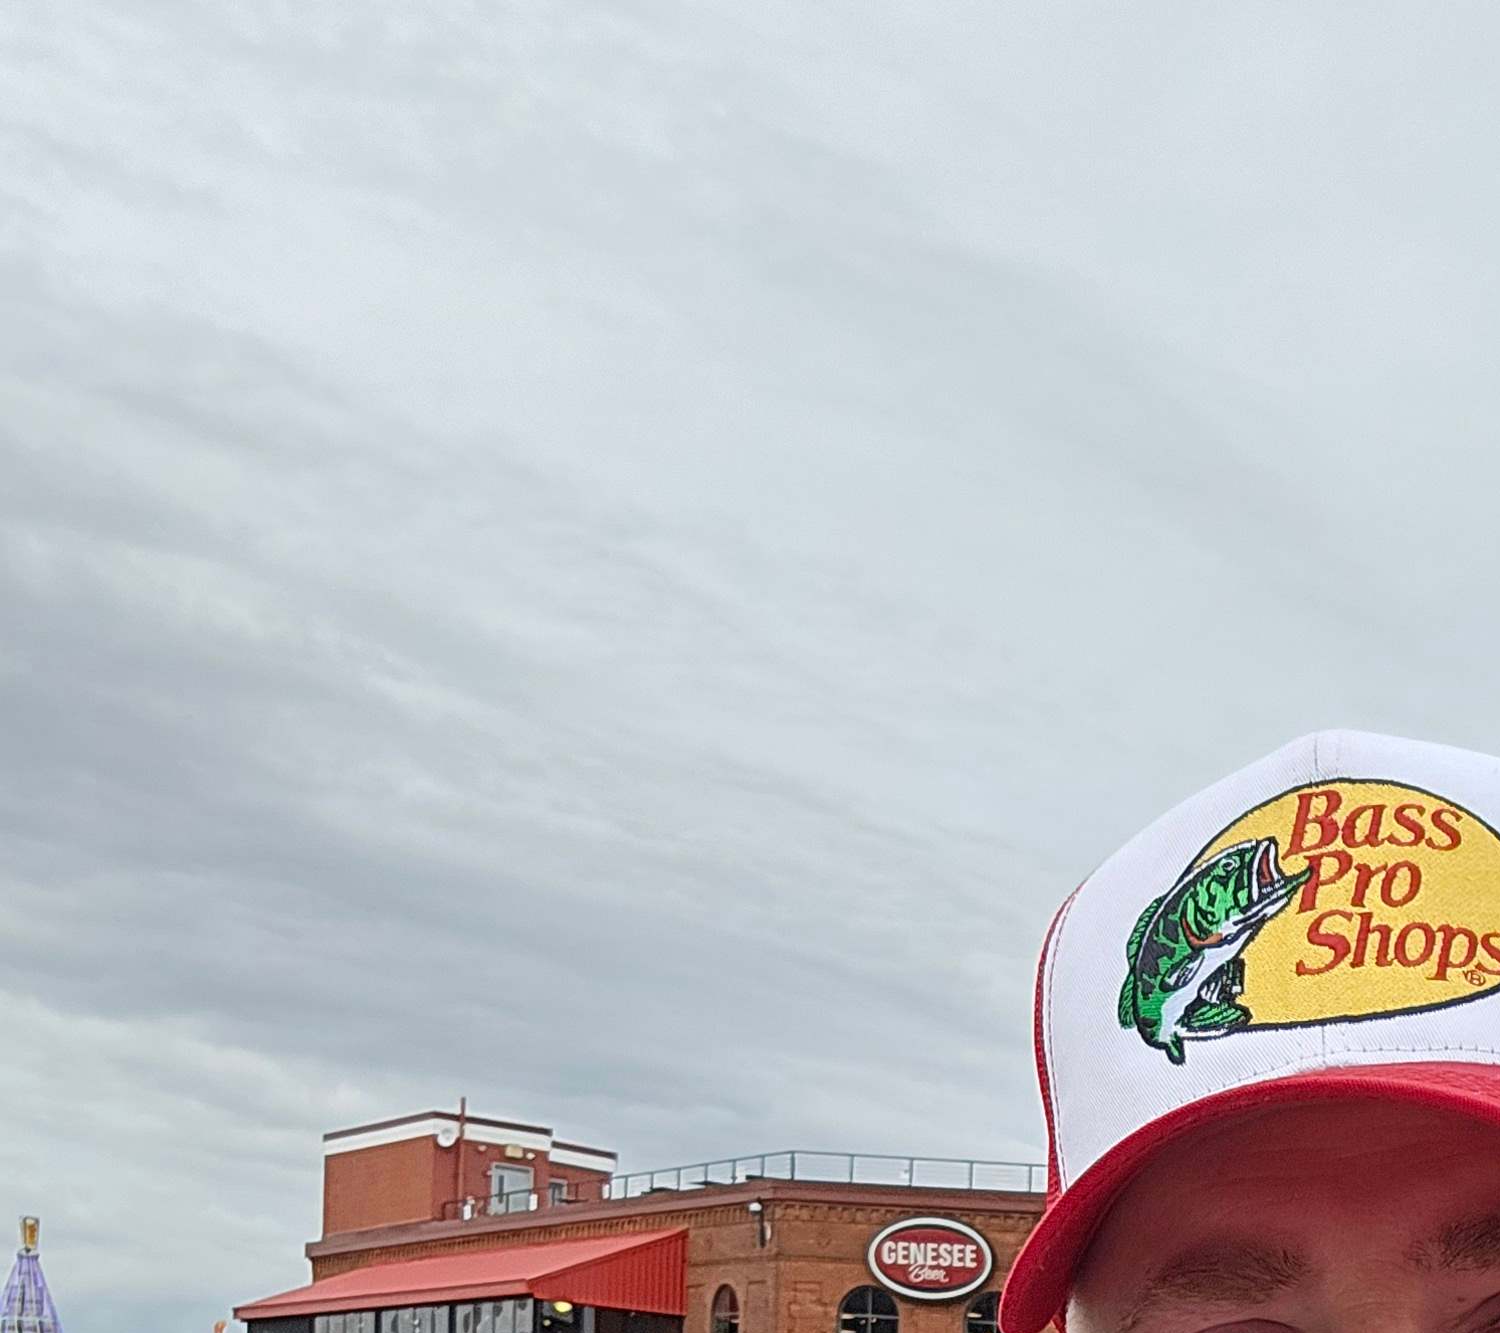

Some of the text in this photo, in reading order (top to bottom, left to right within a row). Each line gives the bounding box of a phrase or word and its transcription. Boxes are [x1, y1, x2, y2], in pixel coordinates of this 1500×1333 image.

[1281, 789, 1463, 861] Bass
[1296, 849, 1422, 915] Pro
[882, 1241, 978, 1268] GENESEE
[908, 1263, 949, 1283] Beer
